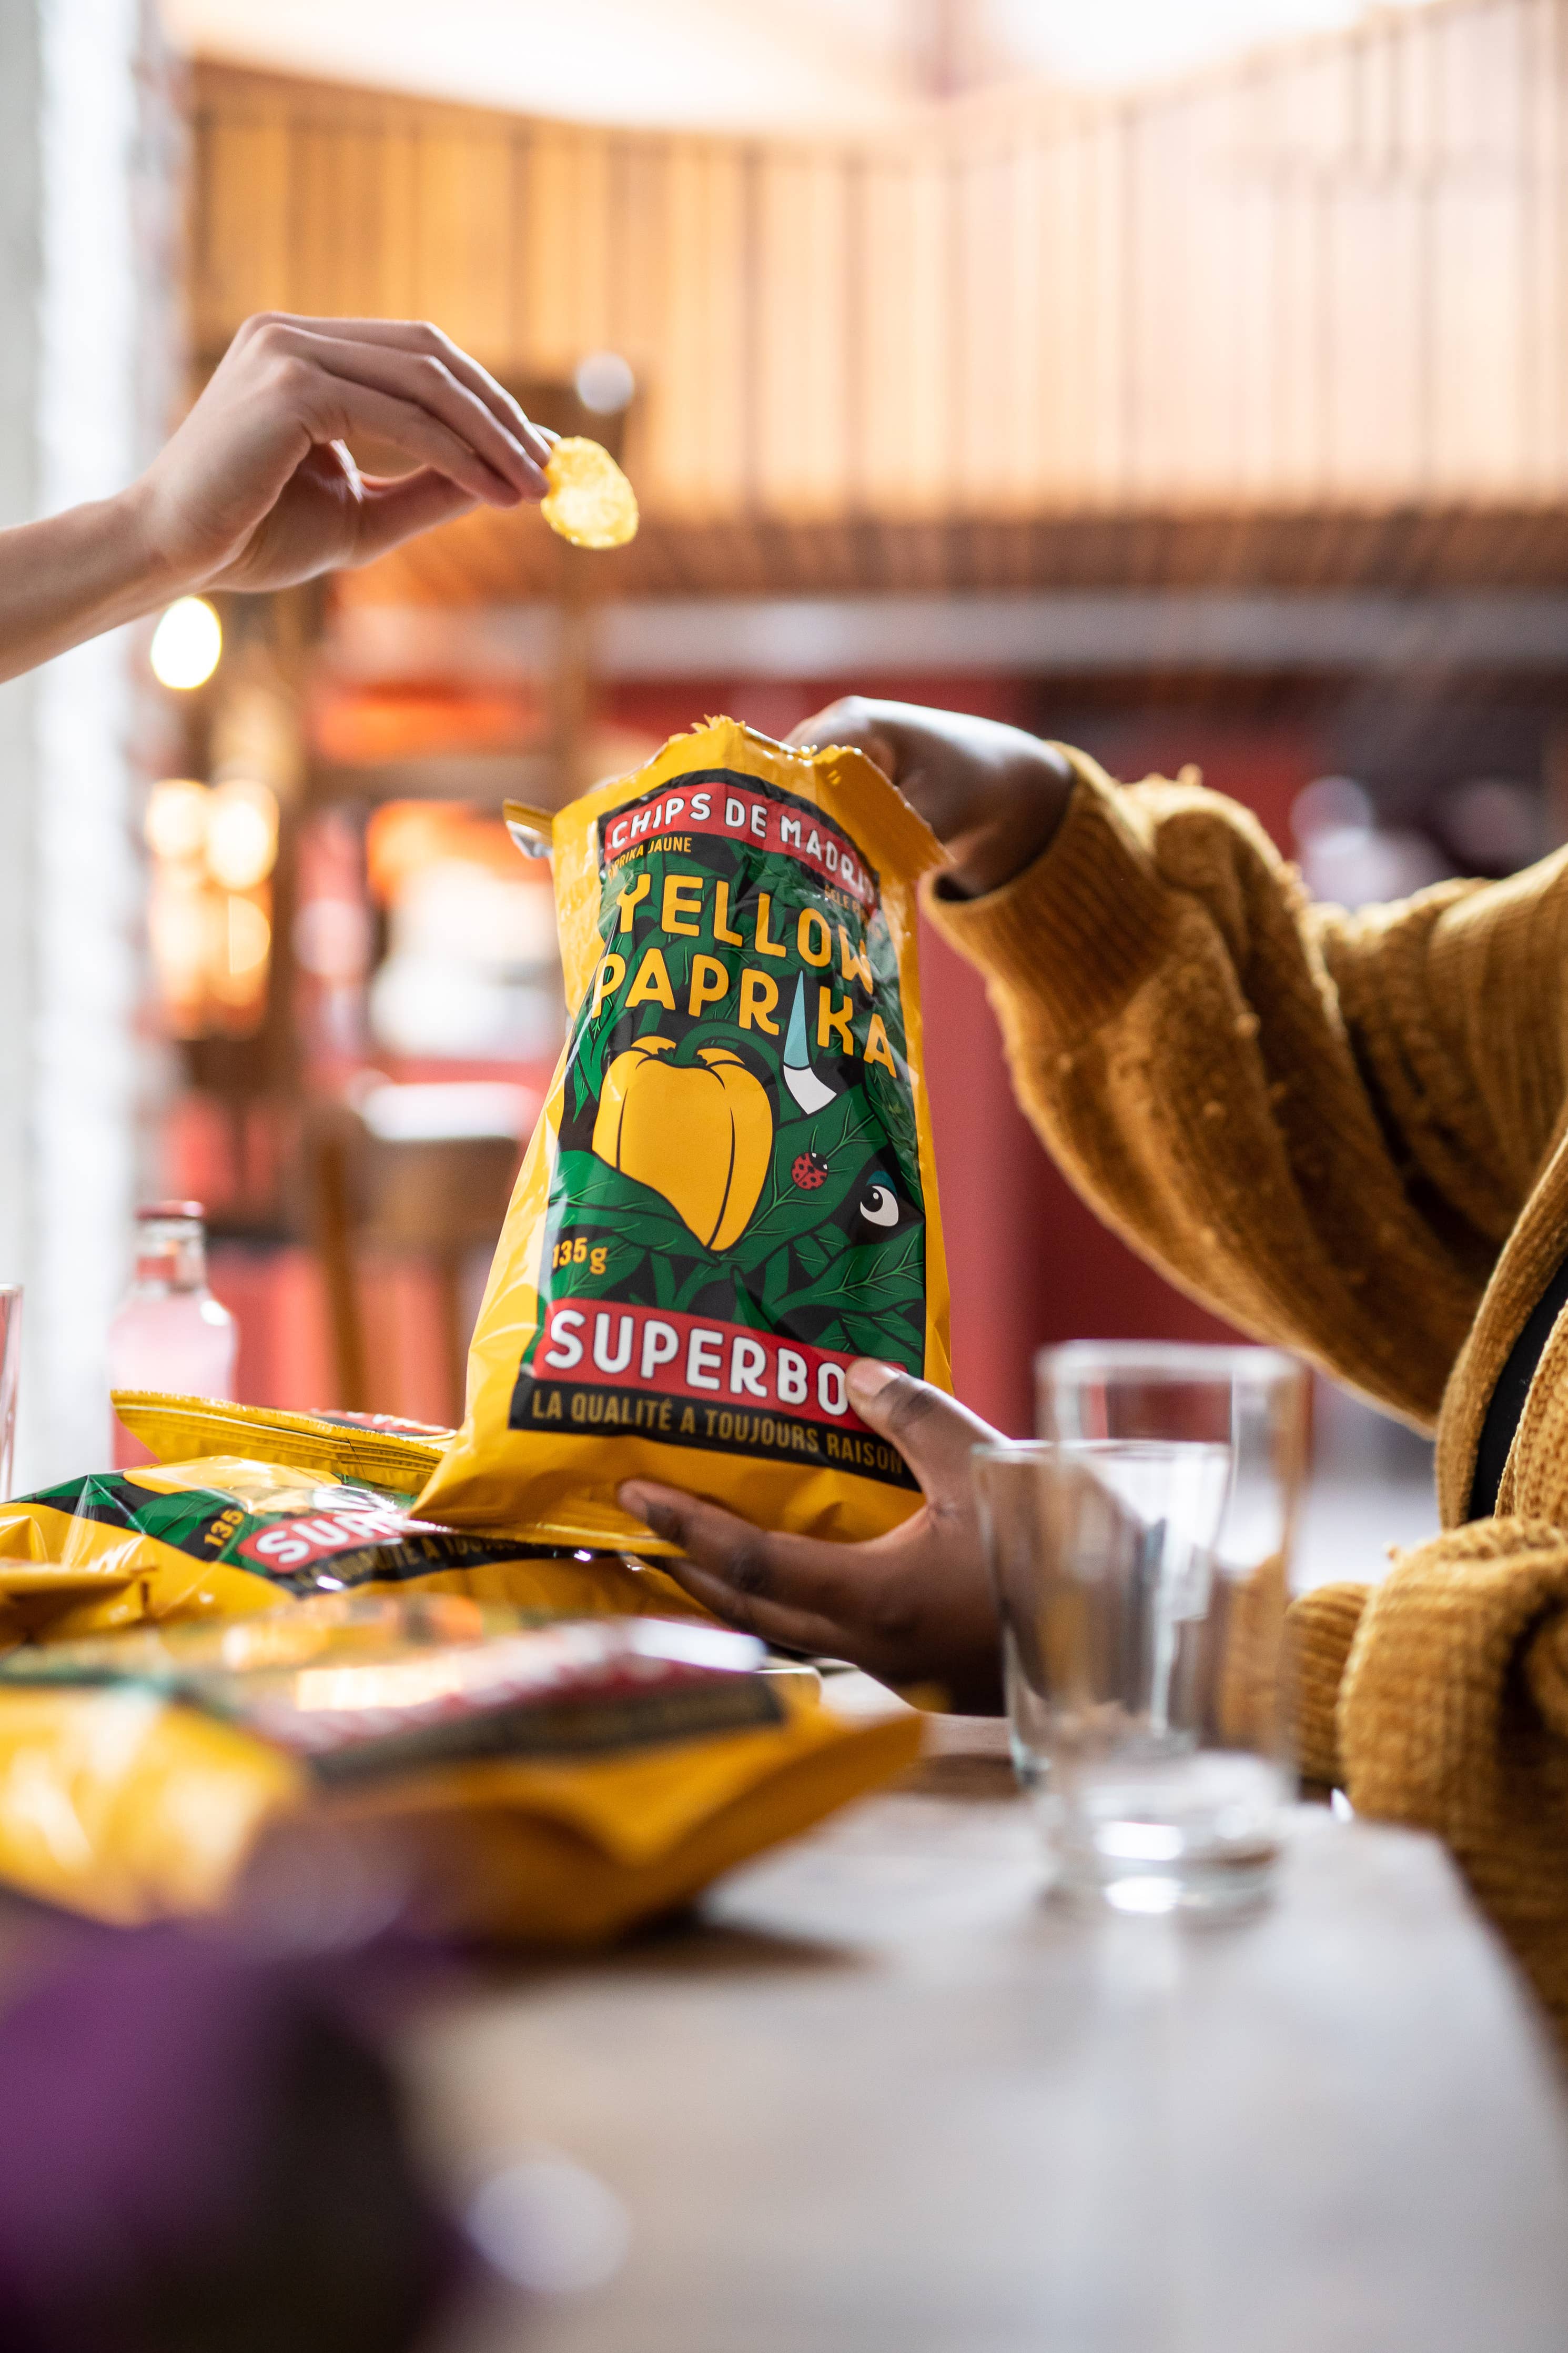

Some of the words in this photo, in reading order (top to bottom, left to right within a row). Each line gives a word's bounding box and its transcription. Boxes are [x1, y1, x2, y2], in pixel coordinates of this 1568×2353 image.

[611, 792, 712, 849] CHIPS
[724, 797, 767, 836] DE
[647, 837, 693, 853] JAUNE
[616, 873, 873, 994] YELLOW
[591, 948, 897, 1078] PAPRIKA
[552, 1236, 588, 1269] 135
[589, 1246, 608, 1275] g
[544, 1309, 849, 1416] SUPERBO
[532, 1389, 562, 1420] LA
[571, 1392, 673, 1432] QUALITÉ
[680, 1405, 696, 1435] A
[704, 1408, 820, 1454] TOUJOURS
[826, 1432, 903, 1474] RAISON
[204, 1509, 245, 1548] 135
